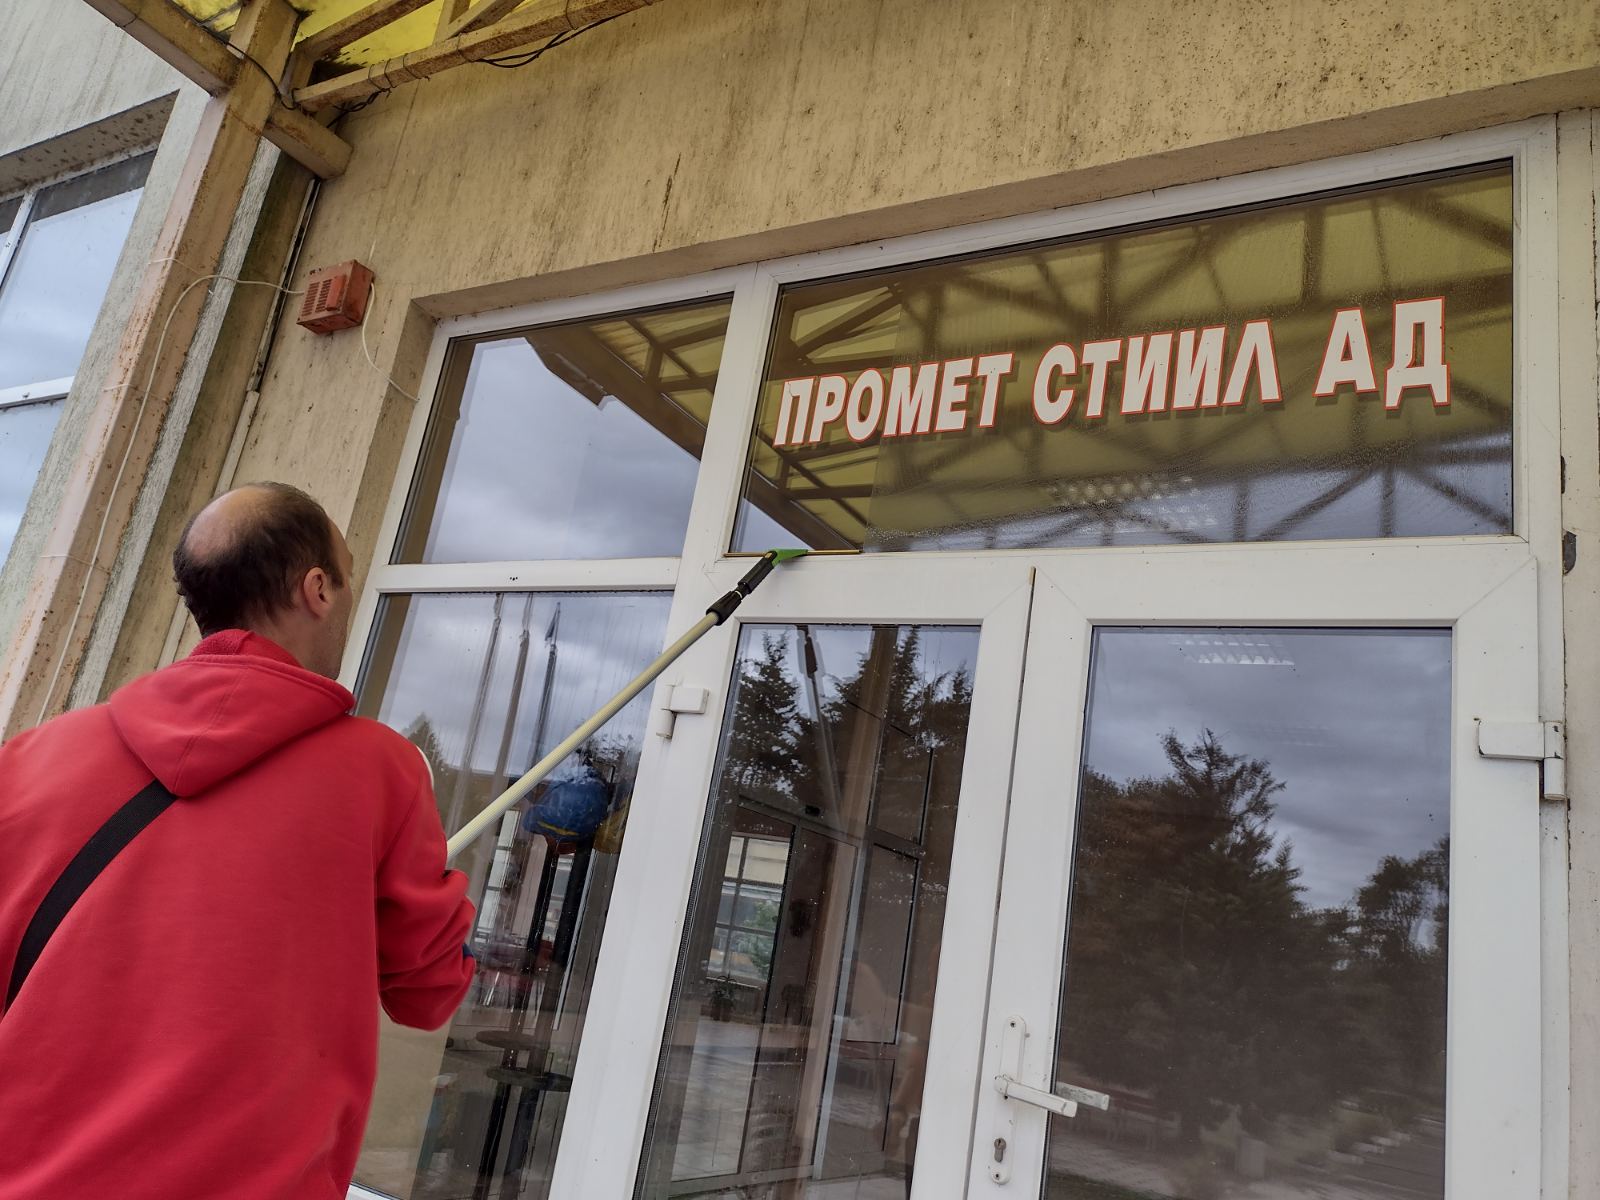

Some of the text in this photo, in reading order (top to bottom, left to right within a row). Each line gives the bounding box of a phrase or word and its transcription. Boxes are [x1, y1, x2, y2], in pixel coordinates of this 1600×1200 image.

[772, 296, 1451, 448] ПРОМЕТ СТИИЛ АД
